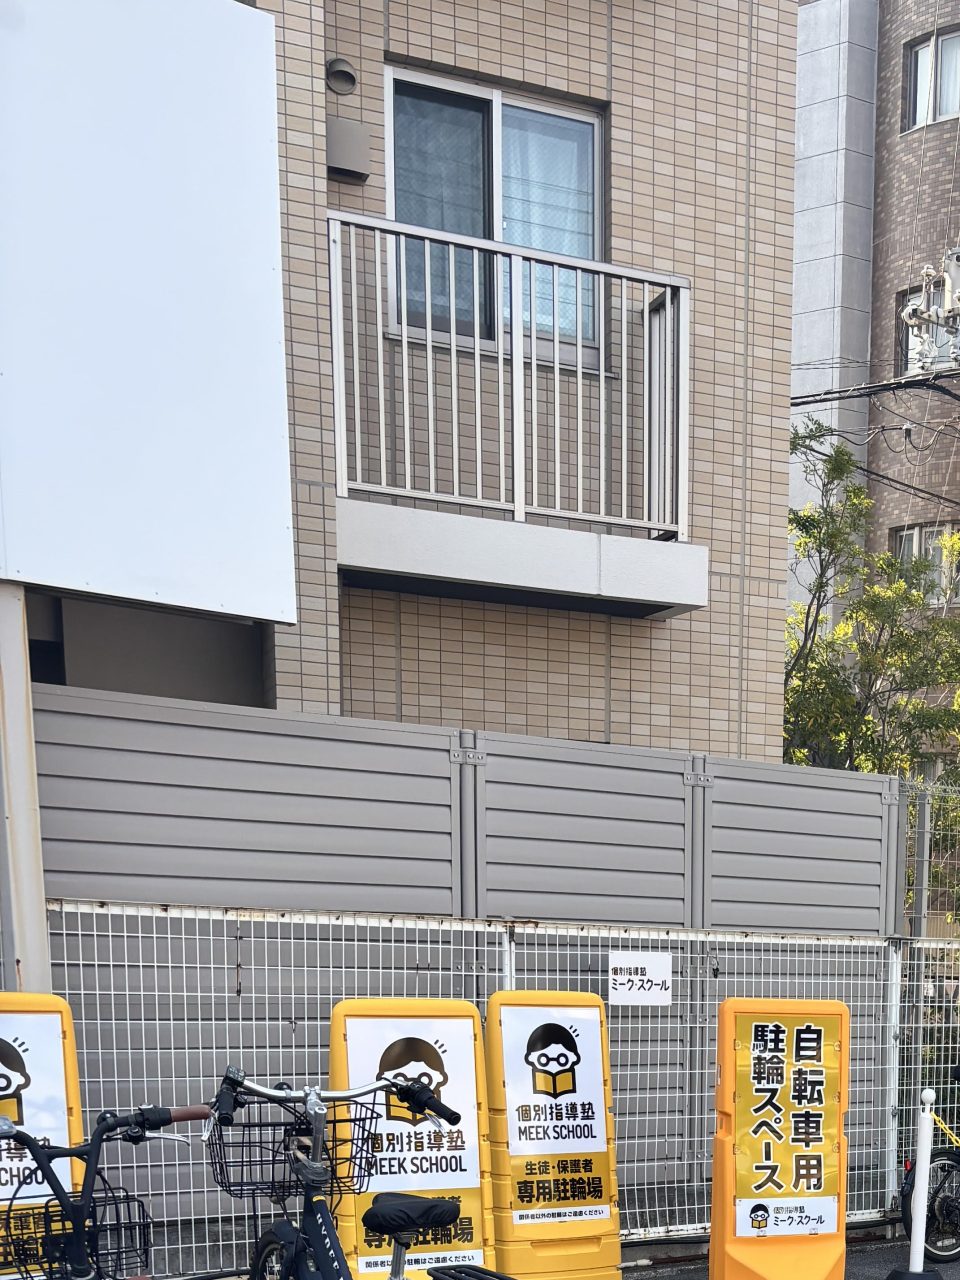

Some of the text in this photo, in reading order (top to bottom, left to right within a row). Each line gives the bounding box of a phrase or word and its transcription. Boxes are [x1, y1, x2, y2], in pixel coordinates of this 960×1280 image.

[611, 978, 670, 991] ミーク・スクール
[515, 1101, 596, 1122] 個別指導塾
[751, 1022, 787, 1193] 駐輪スペース
[791, 1023, 825, 1192] 自転車用
[518, 1124, 597, 1141] MEEK SCHOOL
[365, 1155, 467, 1176] MEEK SCHOOL
[525, 1158, 594, 1175] 生徒・保護者
[516, 1176, 604, 1203] 専用駐輪場
